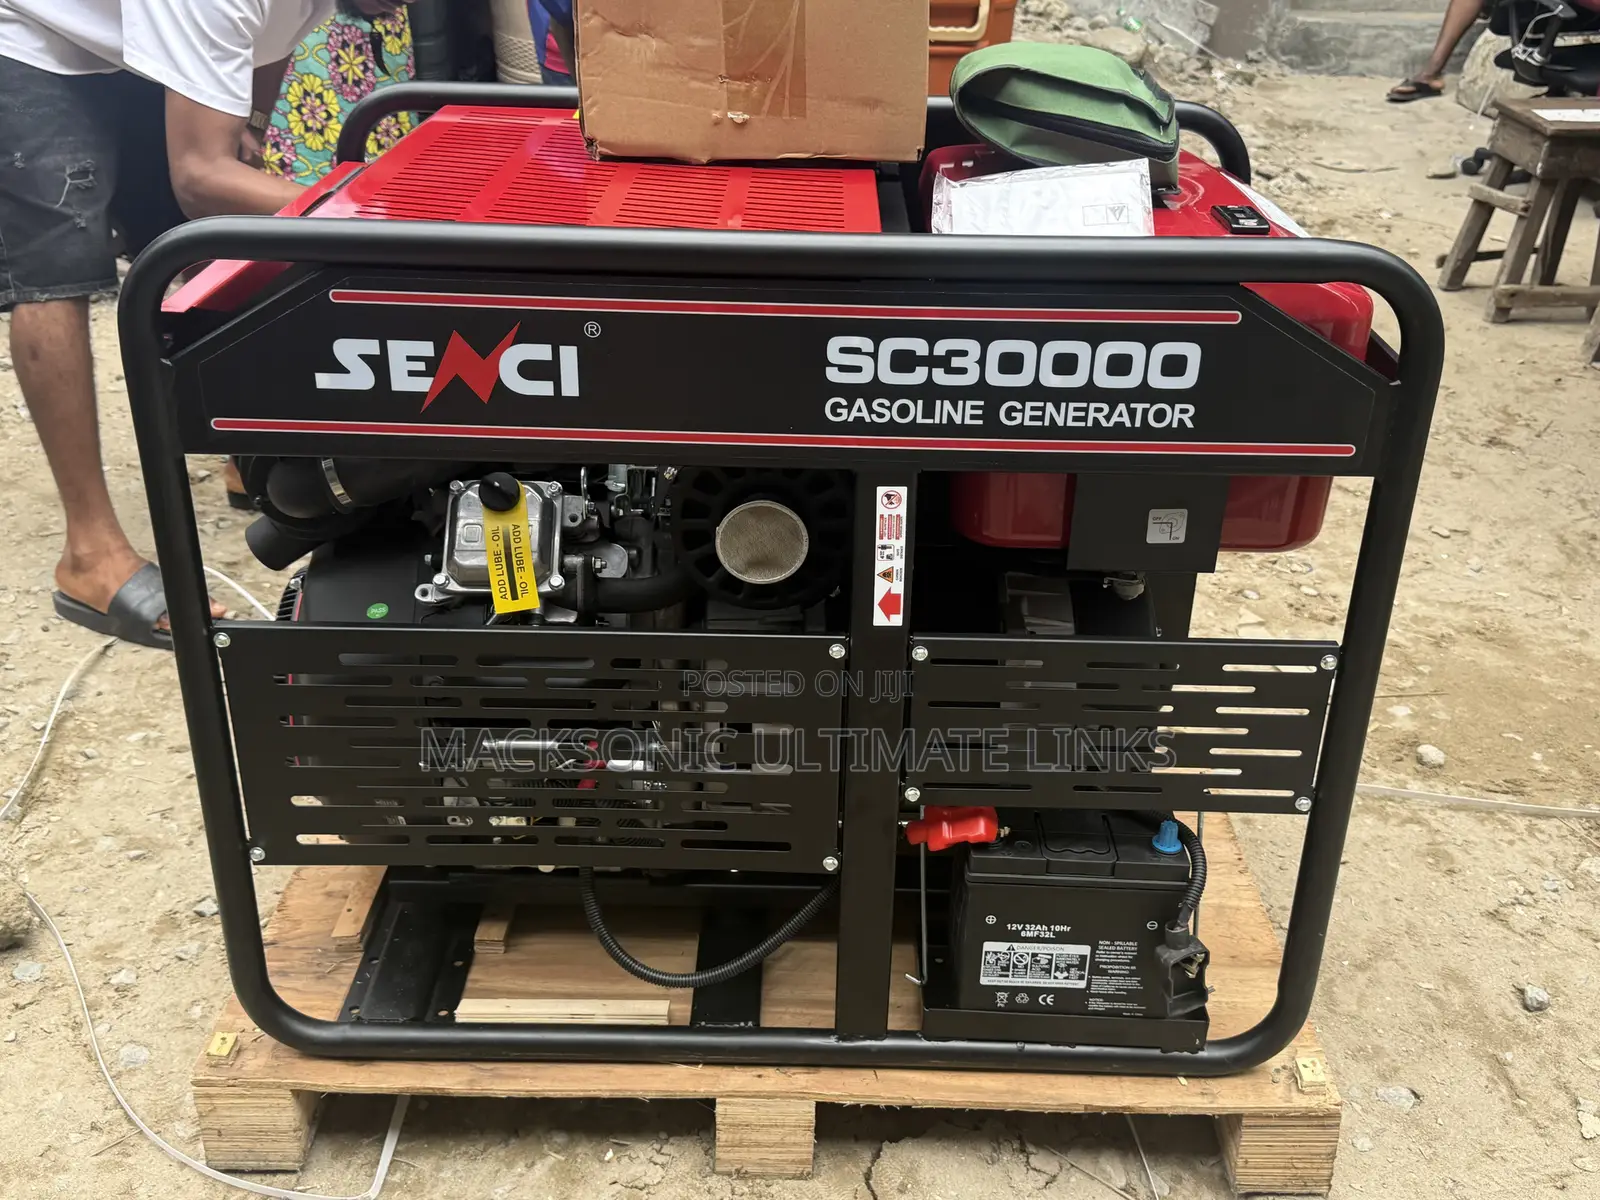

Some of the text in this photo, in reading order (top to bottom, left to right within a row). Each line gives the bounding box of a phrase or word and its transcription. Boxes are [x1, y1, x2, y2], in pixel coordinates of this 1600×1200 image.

[315, 320, 579, 413] SENCI
[826, 336, 1201, 389] SC30000
[824, 397, 1195, 428] GASOLINE GENERATOR
[492, 526, 500, 542] OIL
[512, 524, 522, 544] ADD
[493, 550, 504, 576] LUBE
[514, 546, 525, 573] LUBE
[498, 580, 508, 600] ADD
[520, 582, 529, 598] OIL
